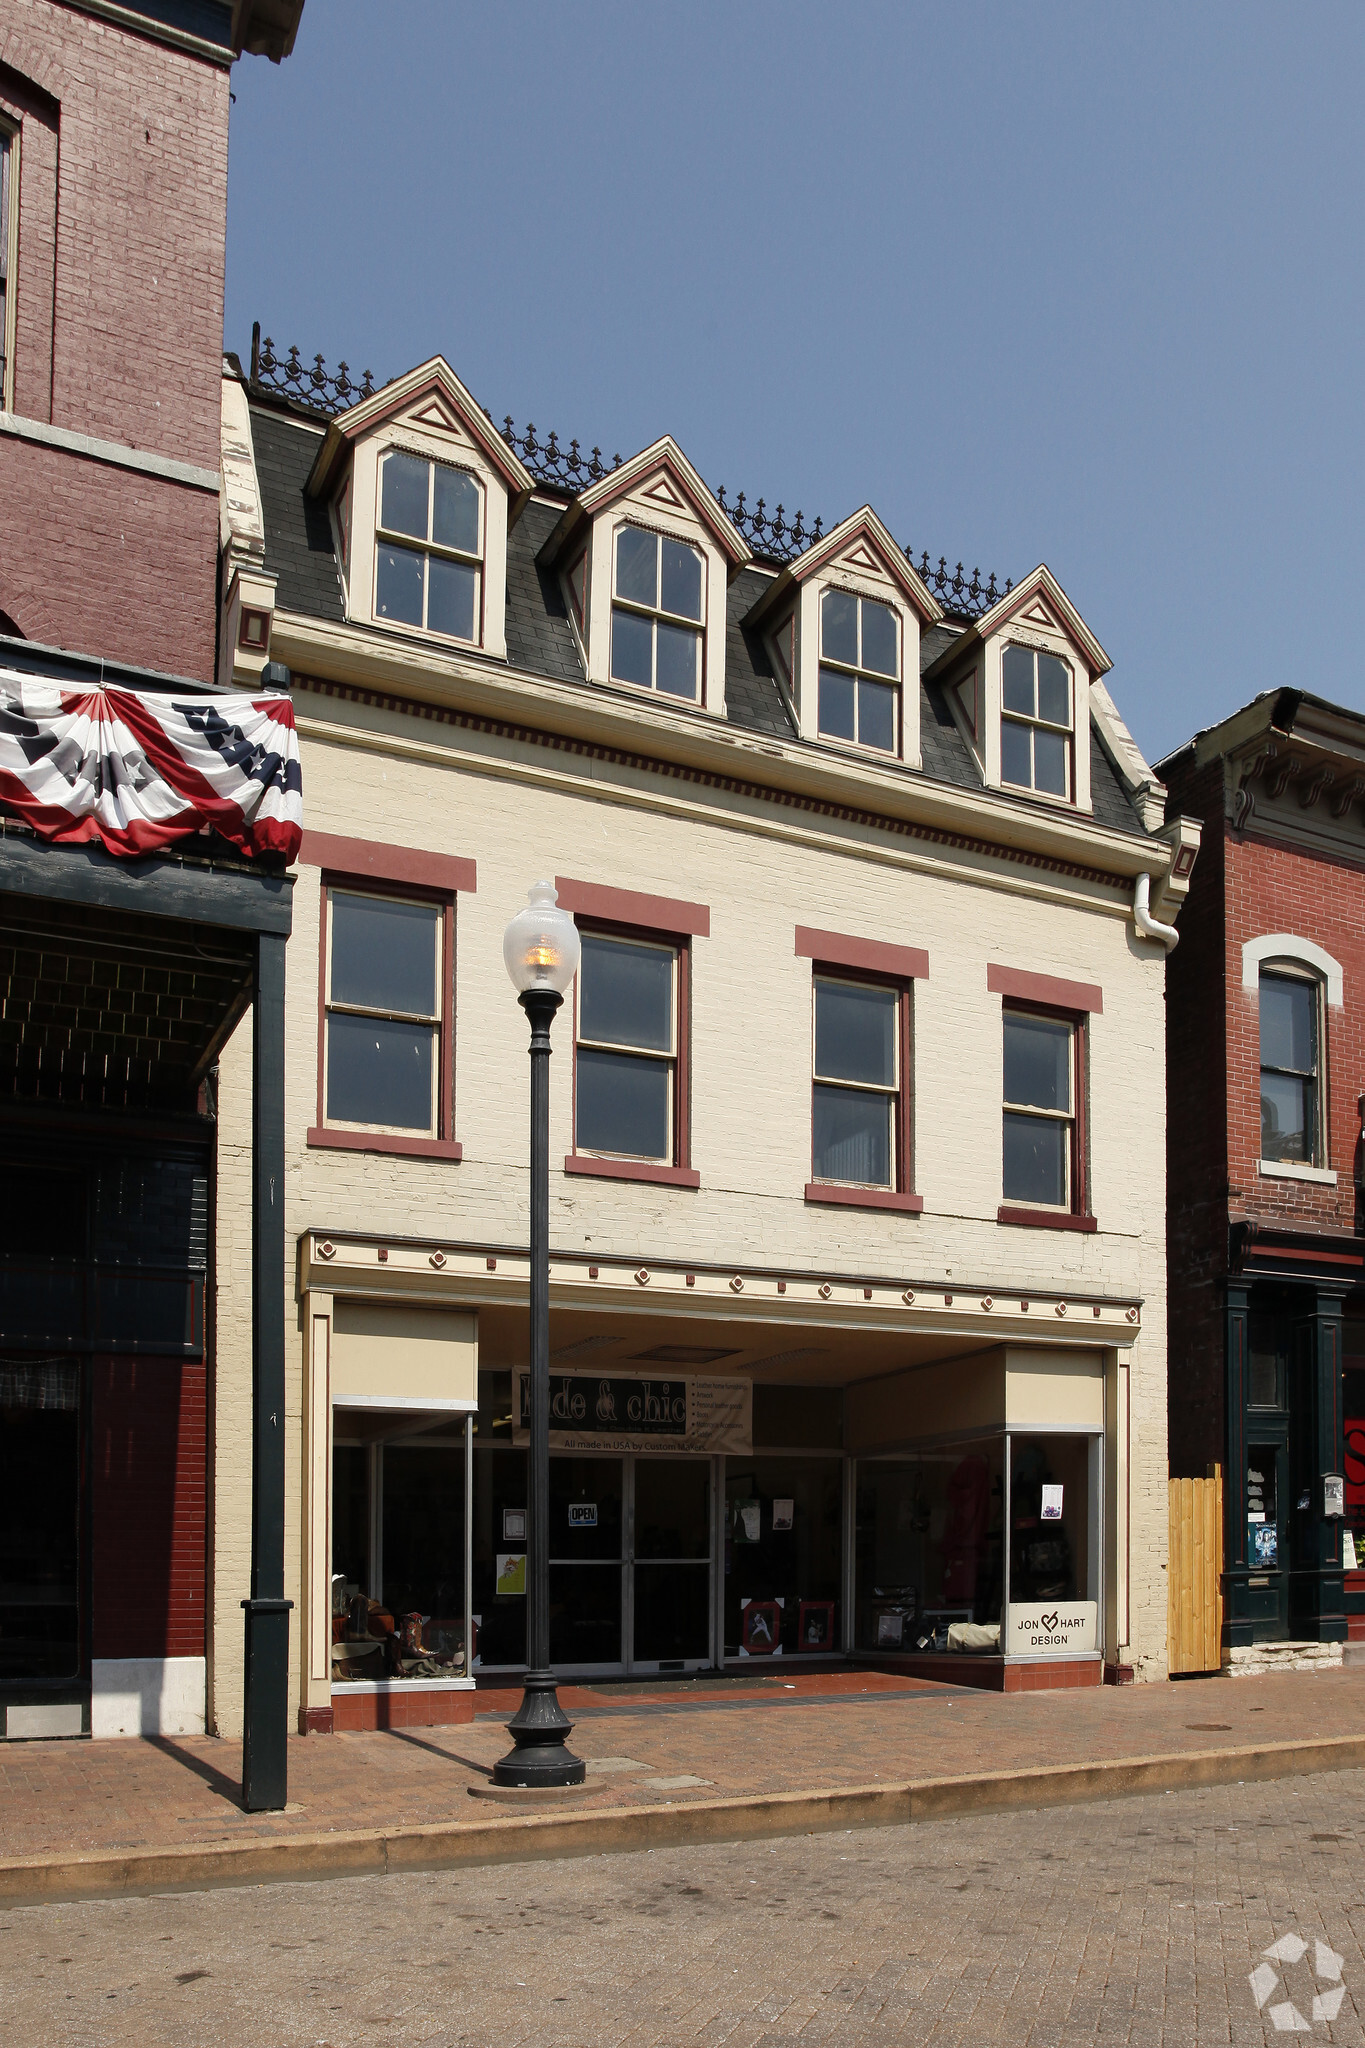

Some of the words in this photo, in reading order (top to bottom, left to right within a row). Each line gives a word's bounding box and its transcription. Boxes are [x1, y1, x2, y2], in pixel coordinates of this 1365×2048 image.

[596, 1379, 618, 1422] &
[627, 1381, 686, 1423] chic
[564, 1439, 576, 1448] All
[577, 1440, 601, 1449] made
[603, 1440, 611, 1449] in
[613, 1441, 630, 1450] USA
[632, 1441, 643, 1452] by
[644, 1441, 676, 1451] Custom
[572, 1507, 594, 1520] OPEN
[1017, 1620, 1039, 1630] JON
[1060, 1618, 1085, 1628] HART
[1031, 1635, 1068, 1645] DESIGN
